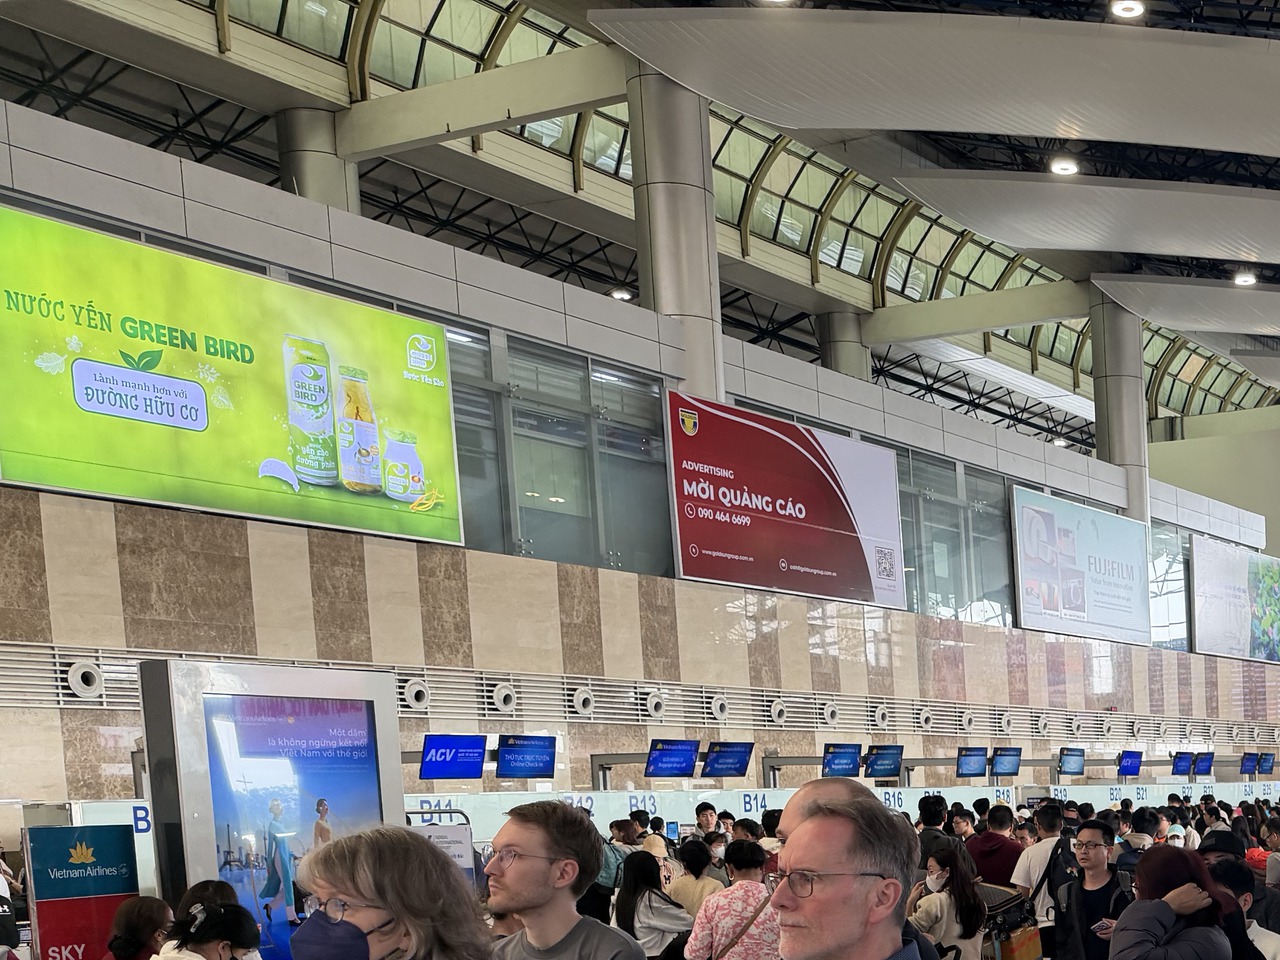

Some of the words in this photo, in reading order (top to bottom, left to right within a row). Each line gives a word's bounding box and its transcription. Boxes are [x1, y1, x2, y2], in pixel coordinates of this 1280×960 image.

[4, 289, 65, 322] NƯỚC
[70, 300, 112, 332] YẾN
[120, 316, 198, 352] GREEN
[204, 335, 255, 364] BIRD
[93, 373, 119, 386] Lành
[121, 379, 150, 393] mạnh
[153, 384, 171, 396] hơn
[173, 387, 188, 399] với
[294, 380, 325, 394] GREEN
[294, 390, 318, 402] BIRD
[84, 386, 139, 411] ĐƯỜNG
[143, 396, 175, 418] HỮU
[180, 404, 199, 422] CƠ
[682, 460, 734, 479] ADVERTISING
[683, 478, 714, 501] MỜI
[718, 486, 772, 513] QUẢNG
[776, 498, 806, 519] CÁO
[698, 507, 713, 520] 090
[715, 510, 730, 523] 464
[732, 513, 751, 526] 6699
[1088, 555, 1134, 581] FUJIFILM
[329, 729, 345, 737] Một
[268, 738, 276, 746] là
[278, 738, 307, 748] không
[308, 738, 337, 749] ngừng
[339, 738, 353, 747] kết
[280, 748, 297, 757] Việt
[300, 749, 320, 757] Nam
[322, 749, 335, 757] với
[336, 748, 351, 757] thế
[352, 749, 368, 760] giới
[425, 748, 456, 762] ACV
[995, 789, 1011, 803] B18
[1054, 788, 1068, 801] B19
[1109, 788, 1122, 801] B20
[1136, 786, 1148, 800] B21
[1182, 786, 1193, 799] B22
[1243, 784, 1254, 796] B24
[564, 796, 595, 817] B12
[629, 795, 657, 815] B13
[743, 793, 767, 813] B14
[884, 791, 903, 808] B16
[420, 799, 453, 823] B11
